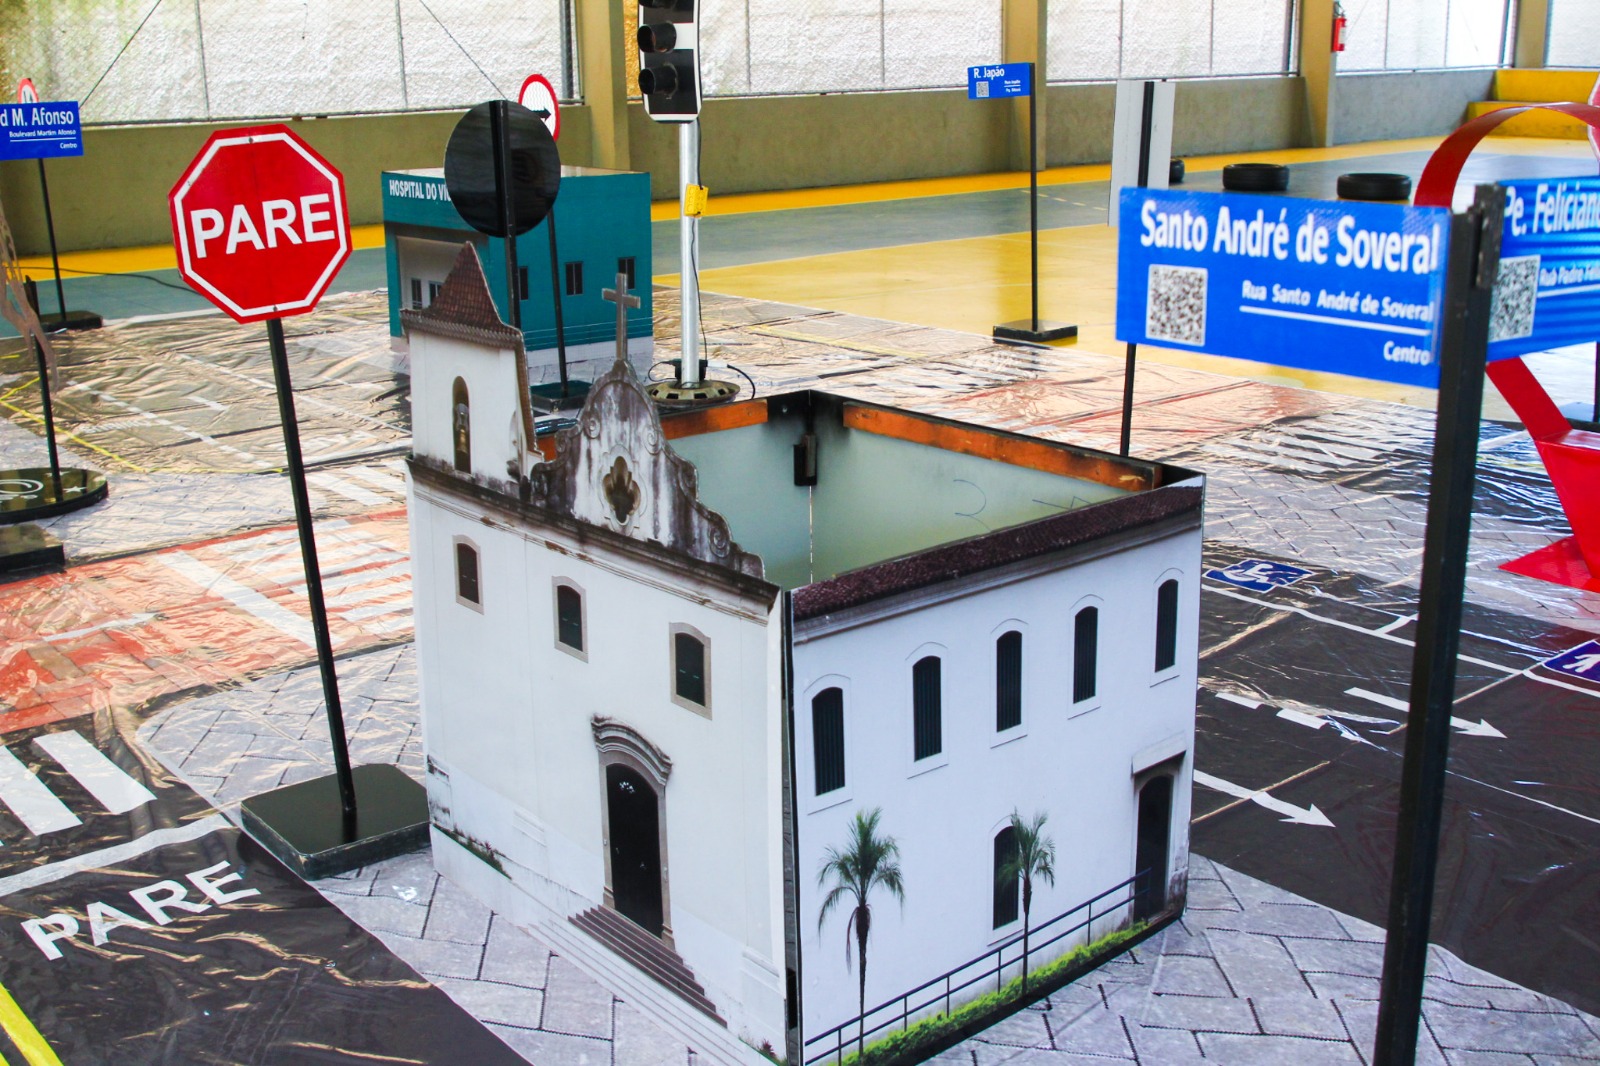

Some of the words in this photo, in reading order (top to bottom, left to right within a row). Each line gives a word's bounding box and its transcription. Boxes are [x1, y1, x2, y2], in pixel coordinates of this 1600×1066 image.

[974, 68, 981, 78] R.
[983, 66, 1005, 80] Japão
[12, 107, 28, 127] M.
[32, 107, 74, 126] Afonso
[9, 130, 36, 138] Boulevard
[389, 179, 424, 199] HOSPITAL
[425, 183, 437, 200] DO
[190, 193, 336, 259] PARE
[1140, 199, 1208, 253] Santo
[1212, 205, 1289, 260] André
[1295, 213, 1330, 265] de
[1335, 214, 1440, 275] Soveral
[1241, 279, 1268, 302] Rua
[1272, 282, 1312, 306] Santo
[1316, 288, 1361, 314] André
[1361, 293, 1380, 316] de
[1381, 296, 1435, 323] Soveral
[1383, 340, 1433, 366] Centro
[20, 860, 262, 961] PARE
